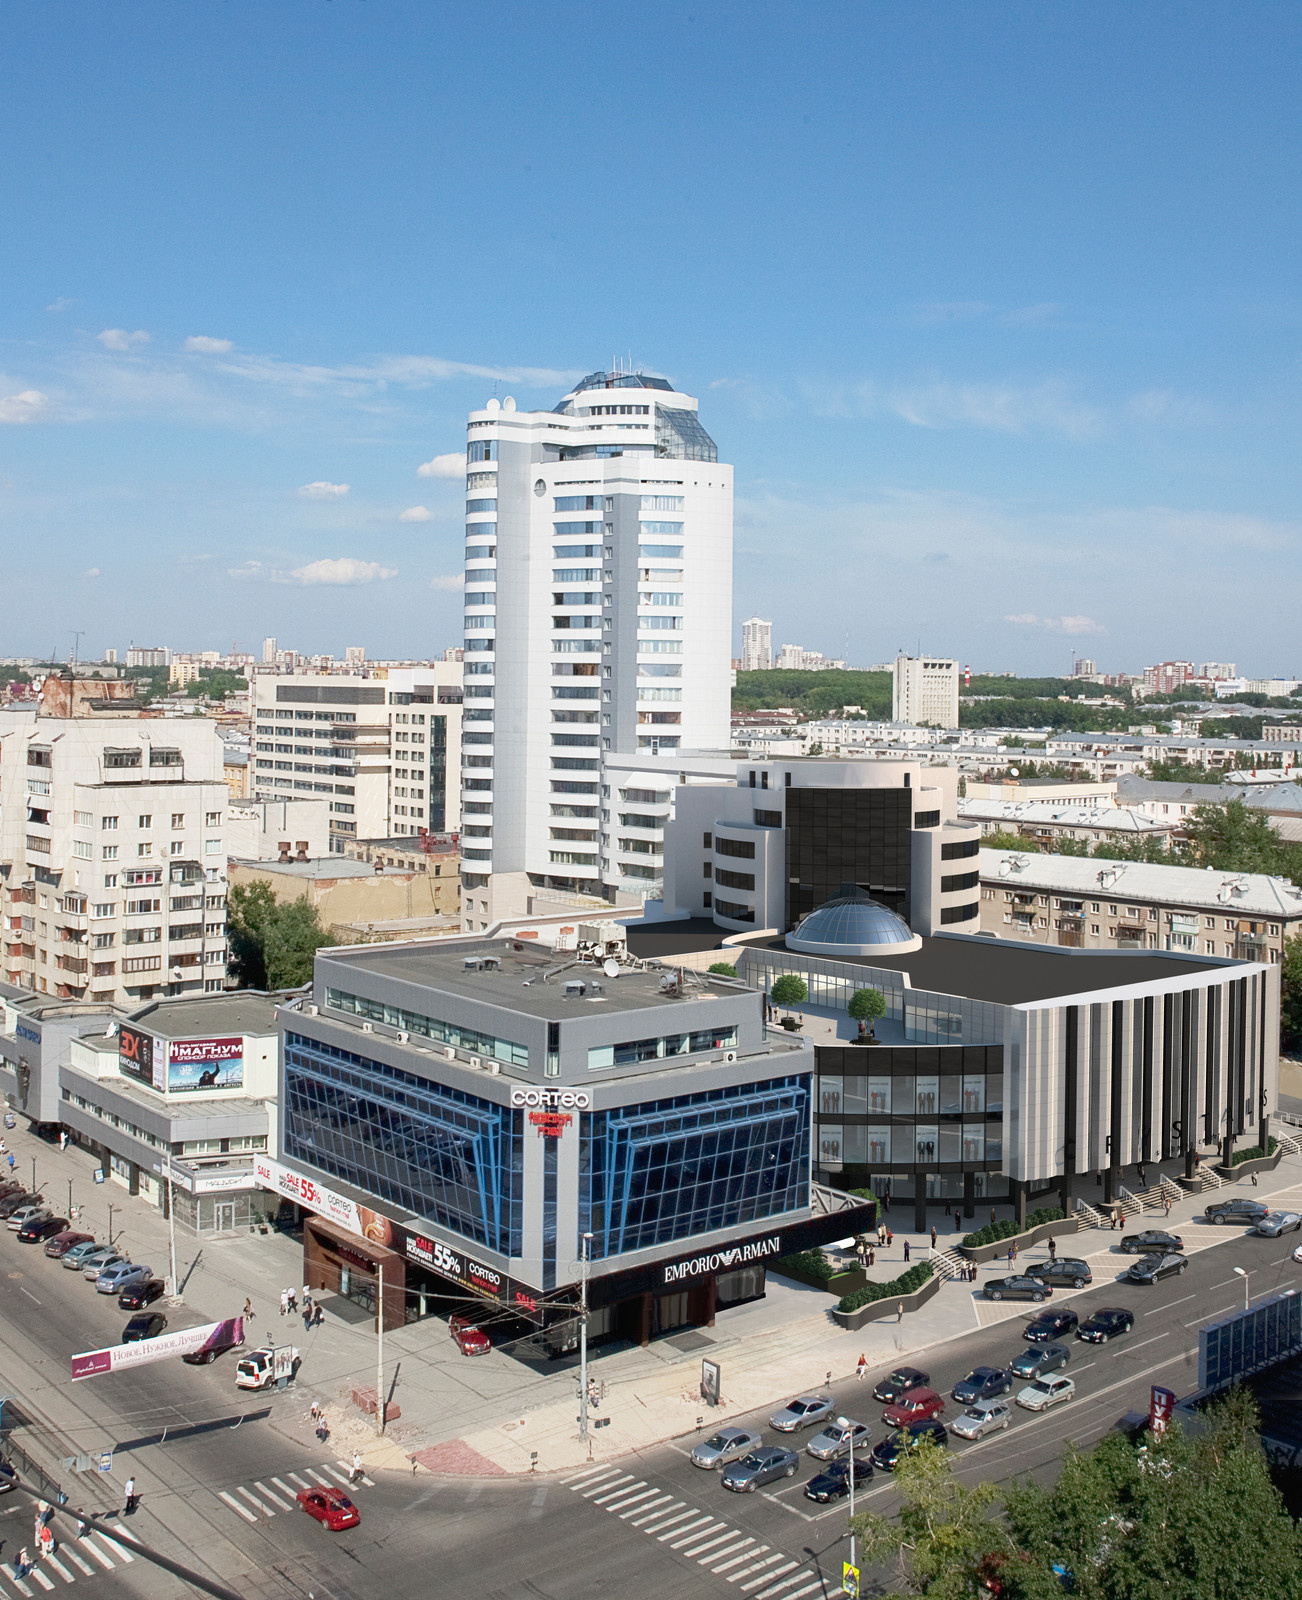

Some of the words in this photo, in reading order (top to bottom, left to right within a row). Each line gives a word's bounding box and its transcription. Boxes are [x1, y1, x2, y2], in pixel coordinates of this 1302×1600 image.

[179, 1044, 243, 1056] МАГНУМ
[257, 1165, 271, 1180] SALE
[286, 1173, 299, 1187] SALE
[301, 1178, 322, 1204] 55%
[416, 1237, 433, 1255] SALE
[433, 1243, 461, 1274] 55%
[664, 1254, 720, 1283] EMPORIO
[734, 1236, 780, 1263] ARMANI
[469, 1262, 501, 1285] CORTEO
[516, 1292, 537, 1312] SALE
